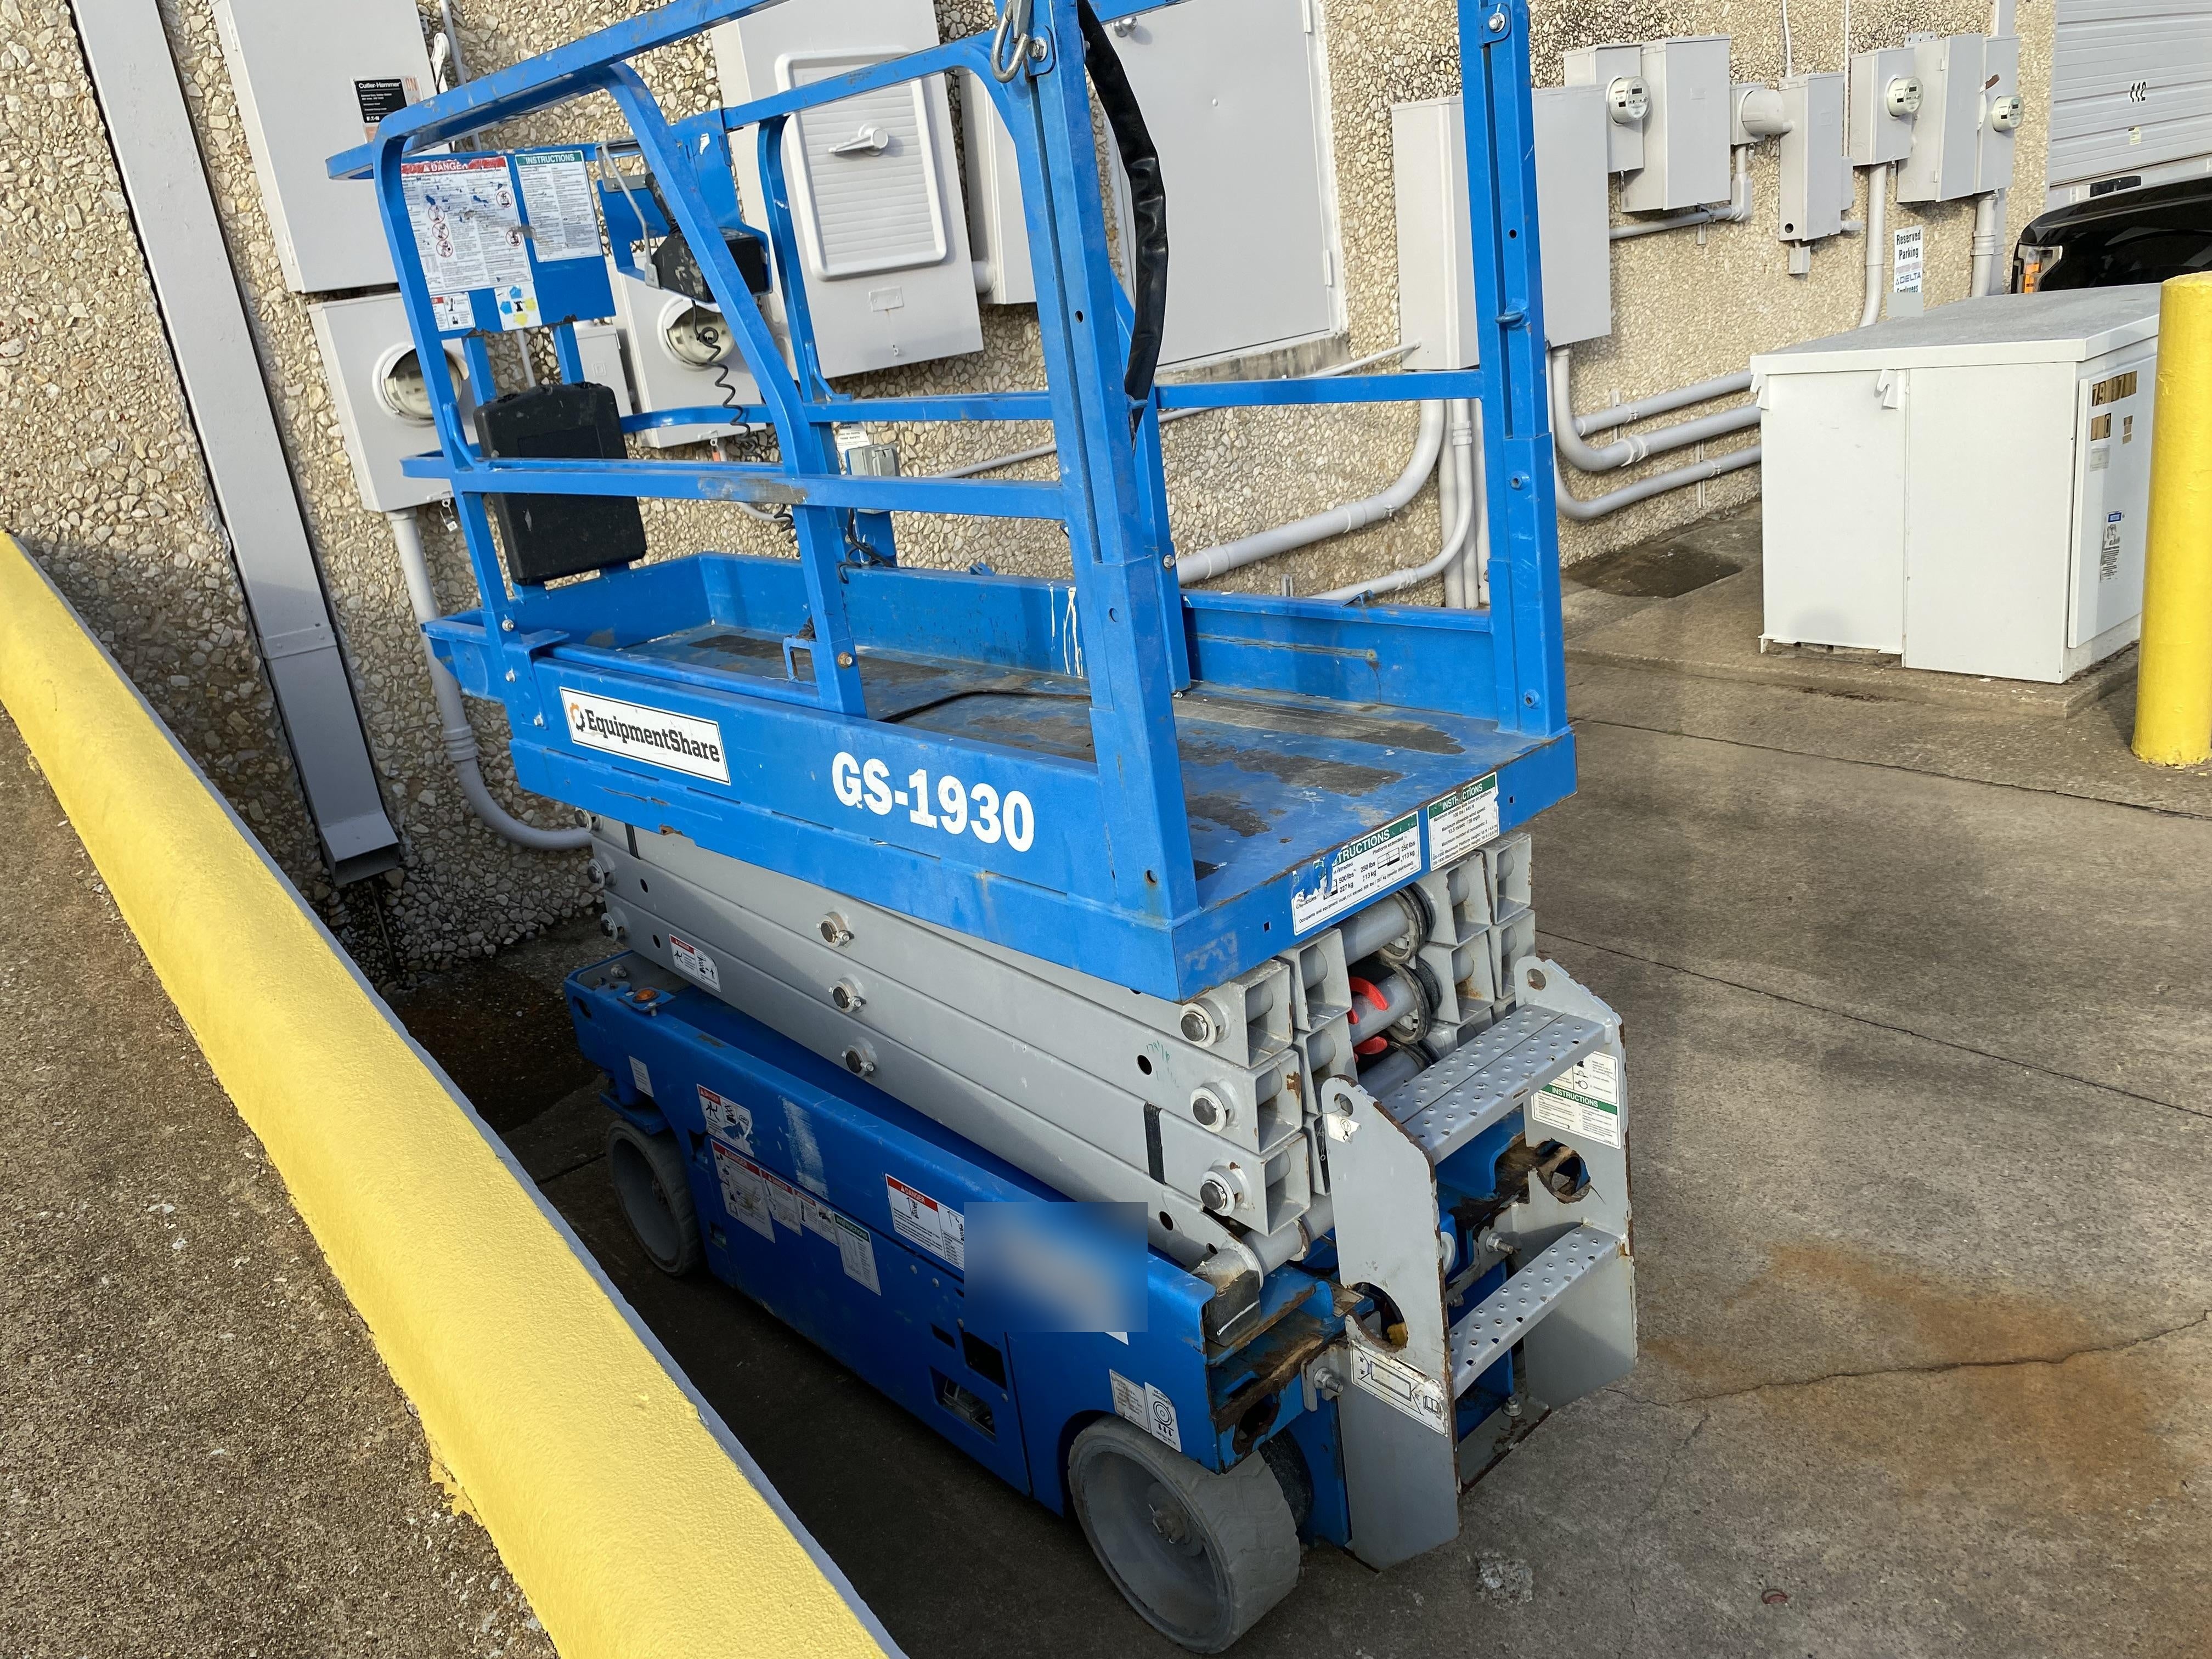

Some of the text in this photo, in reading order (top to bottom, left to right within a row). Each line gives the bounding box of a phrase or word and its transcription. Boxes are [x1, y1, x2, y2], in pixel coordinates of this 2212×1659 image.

[2130, 81, 2146, 103] 112
[525, 154, 575, 165] INSTRUCTIONS
[1897, 229, 1921, 245] Reserved
[1899, 246, 1918, 261] Parking
[1899, 272, 1921, 284] DELTA
[585, 708, 720, 763] EquipmentShare
[832, 752, 1035, 852] GS-1930
[1442, 783, 1483, 810] INSTCTIONS
[1338, 829, 1390, 864] TRUCTIONS
[1373, 836, 1403, 854] Platform extended
[1552, 1087, 1599, 1108] INSTRUCTIONS
[905, 1188, 926, 1204] DANGER
